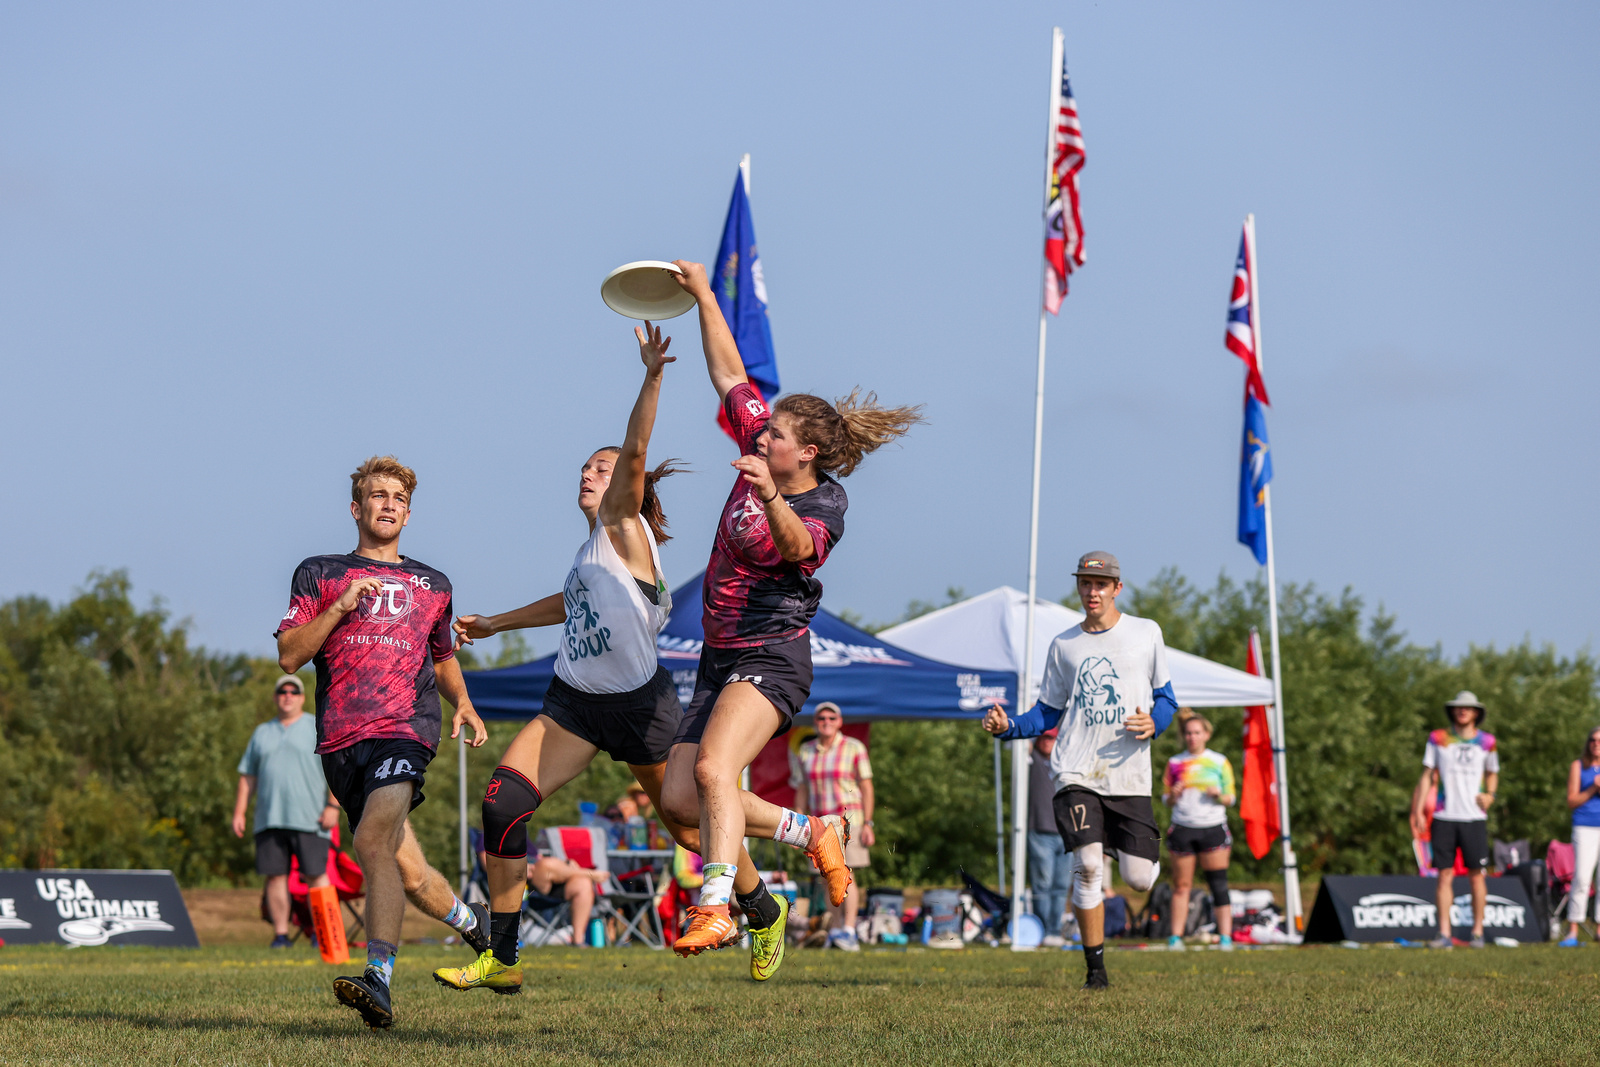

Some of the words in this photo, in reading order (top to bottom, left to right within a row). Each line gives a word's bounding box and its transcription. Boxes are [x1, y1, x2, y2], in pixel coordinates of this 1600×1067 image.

[409, 575, 431, 590] 46
[357, 635, 412, 651] ULTIMATE
[569, 626, 612, 662] SOUP
[1084, 706, 1126, 727] SOUP
[1069, 803, 1091, 832] 12
[35, 877, 96, 901] USA
[56, 899, 162, 920] ULTIMATE
[1351, 903, 1437, 929] DISCRAFT
